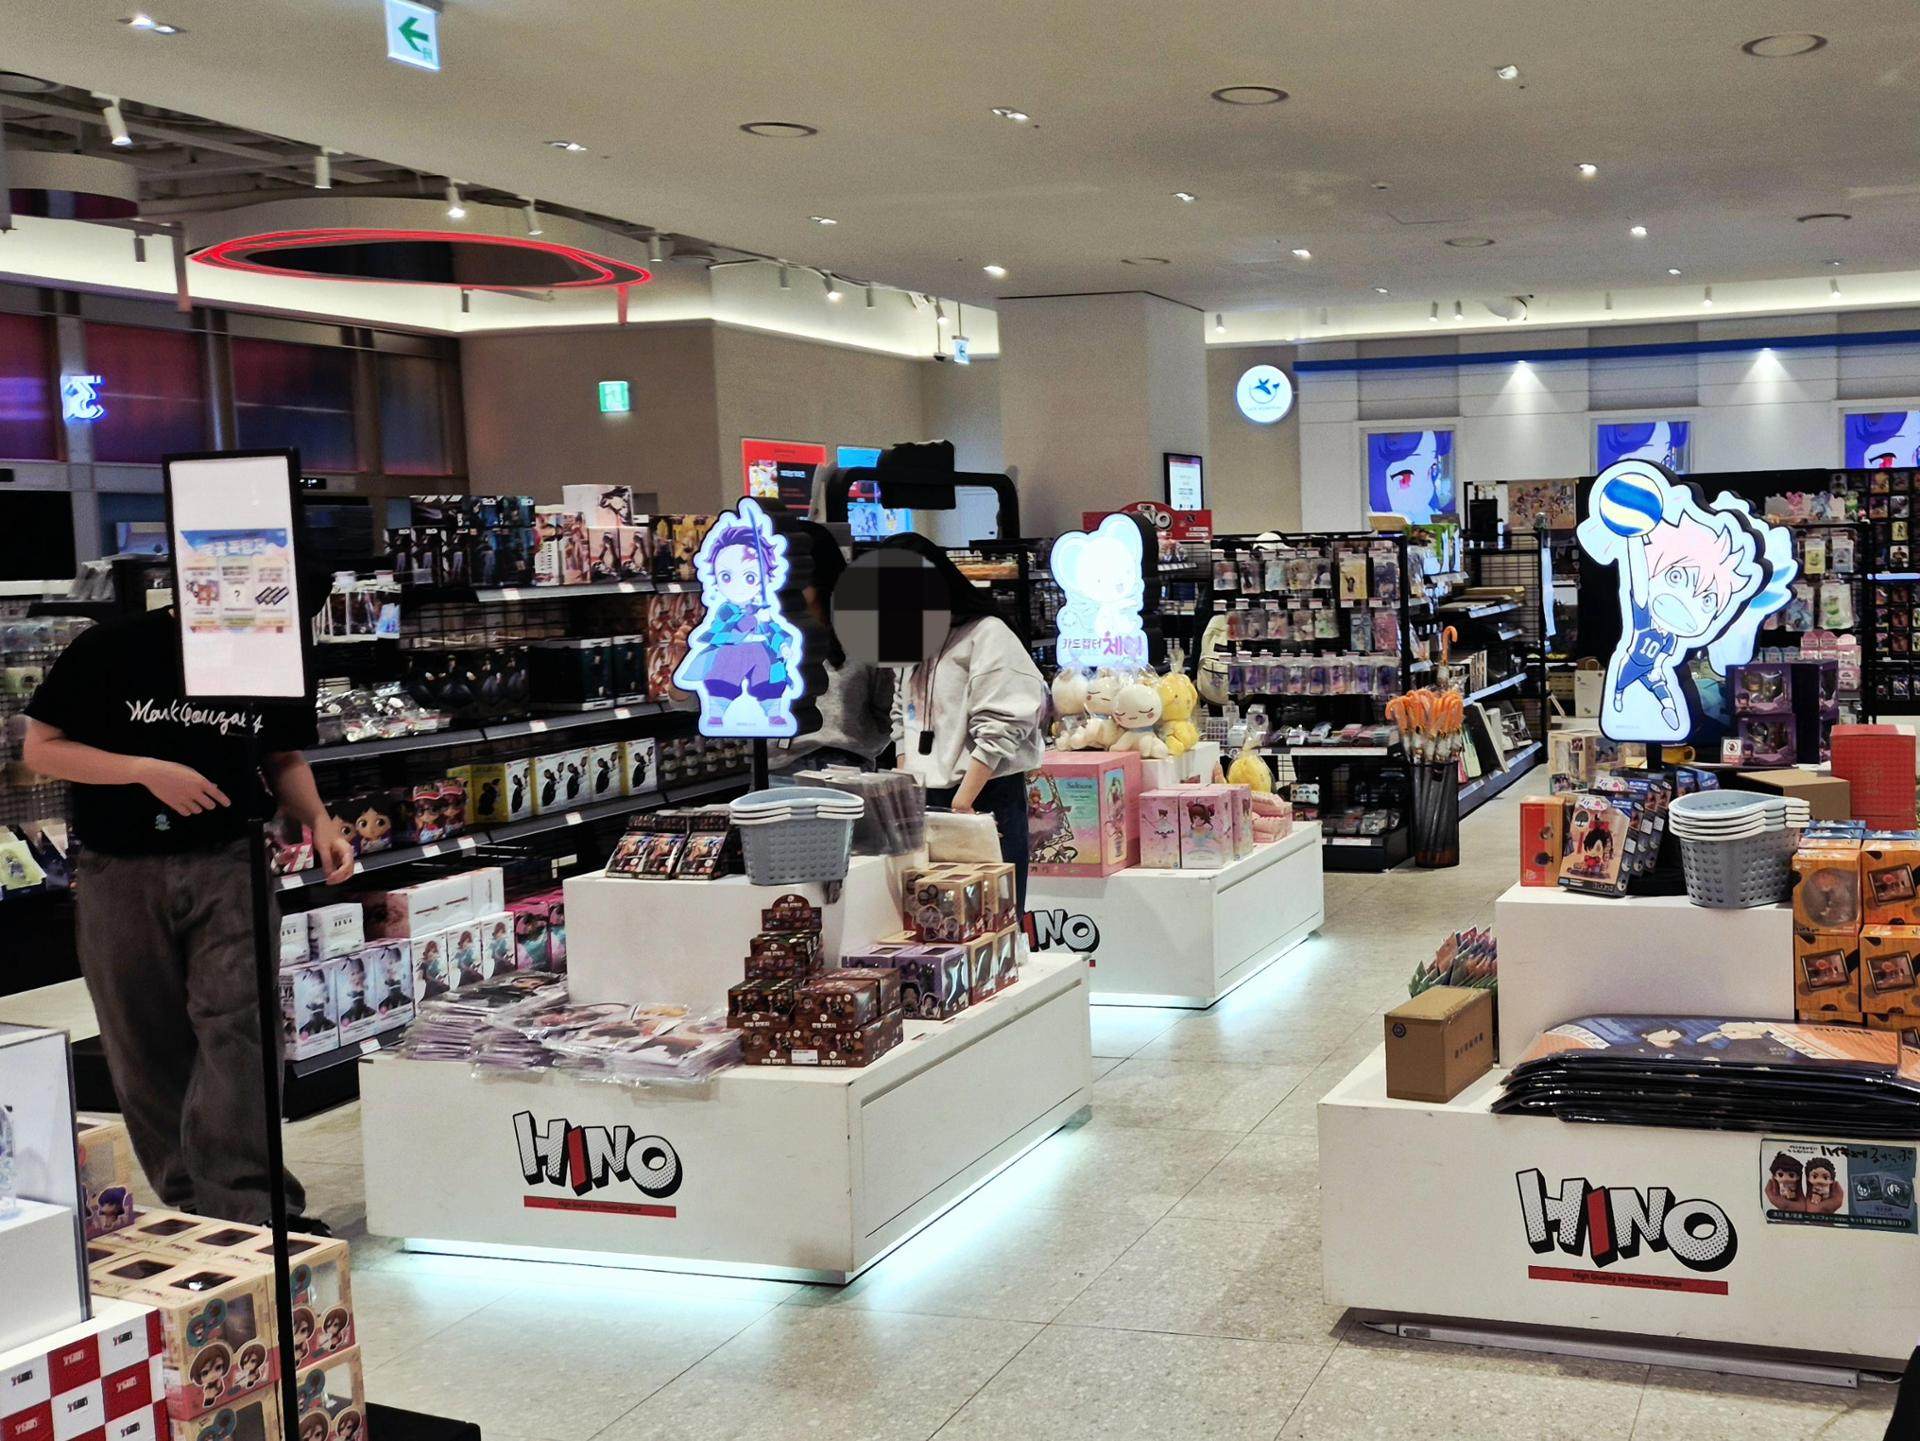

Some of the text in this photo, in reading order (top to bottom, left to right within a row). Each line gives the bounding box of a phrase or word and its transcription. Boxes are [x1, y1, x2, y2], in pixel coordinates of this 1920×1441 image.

[1639, 637, 1660, 659] 10
[125, 698, 179, 723] Mark
[1020, 909, 1100, 953] INO
[512, 1110, 683, 1199] HINO
[1515, 1168, 1738, 1272] HINO
[1573, 1272, 1589, 1281] High
[1591, 1273, 1616, 1283] Quality
[1653, 1278, 1682, 1288] Original
